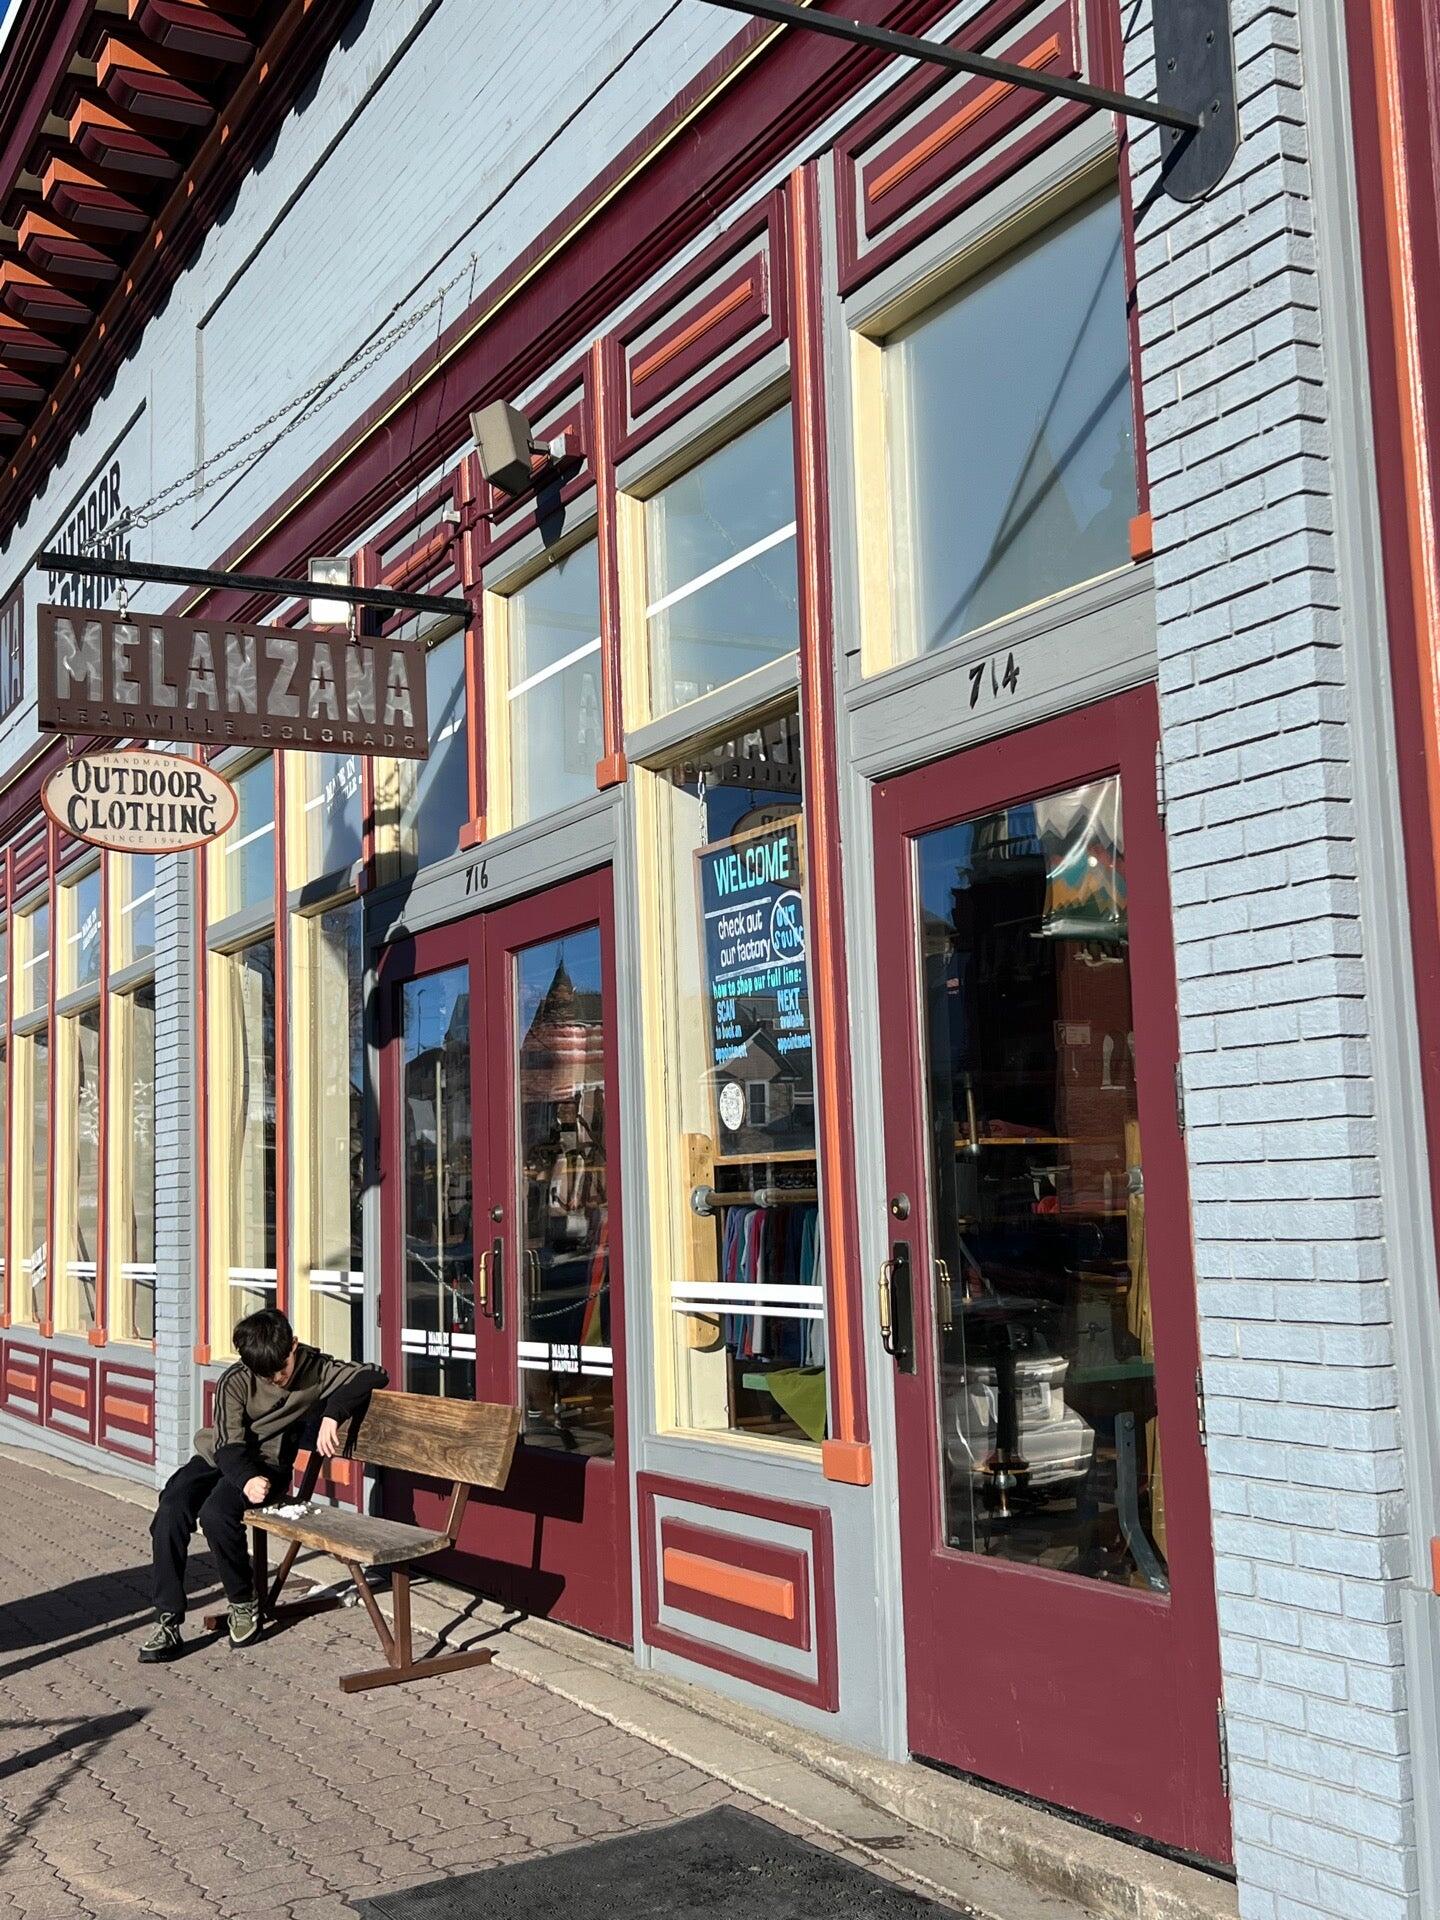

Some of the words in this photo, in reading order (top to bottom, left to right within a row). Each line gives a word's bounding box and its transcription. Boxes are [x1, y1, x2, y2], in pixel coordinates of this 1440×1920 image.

[55, 616, 414, 728] MELANZANA
[969, 652, 1020, 710] 714
[57, 706, 234, 736] LEADVILLE
[262, 723, 416, 749] COLORADO
[103, 756, 178, 768] HANDMADE
[66, 758, 217, 805] OUTDOOR
[67, 793, 217, 836] CLOTHING
[103, 834, 144, 843] SINCE
[153, 836, 183, 845] 1994
[466, 860, 488, 896] 716
[713, 837, 789, 896] WELCOME
[718, 912, 746, 940] check
[746, 909, 763, 935] out
[720, 945, 737, 968] our
[736, 936, 771, 965] factory
[712, 981, 728, 999] how
[727, 980, 736, 997] to
[736, 976, 753, 997] shop
[753, 975, 766, 990] our
[767, 969, 782, 988] full
[777, 988, 800, 1012] NEXT
[717, 999, 735, 1022] SCAN
